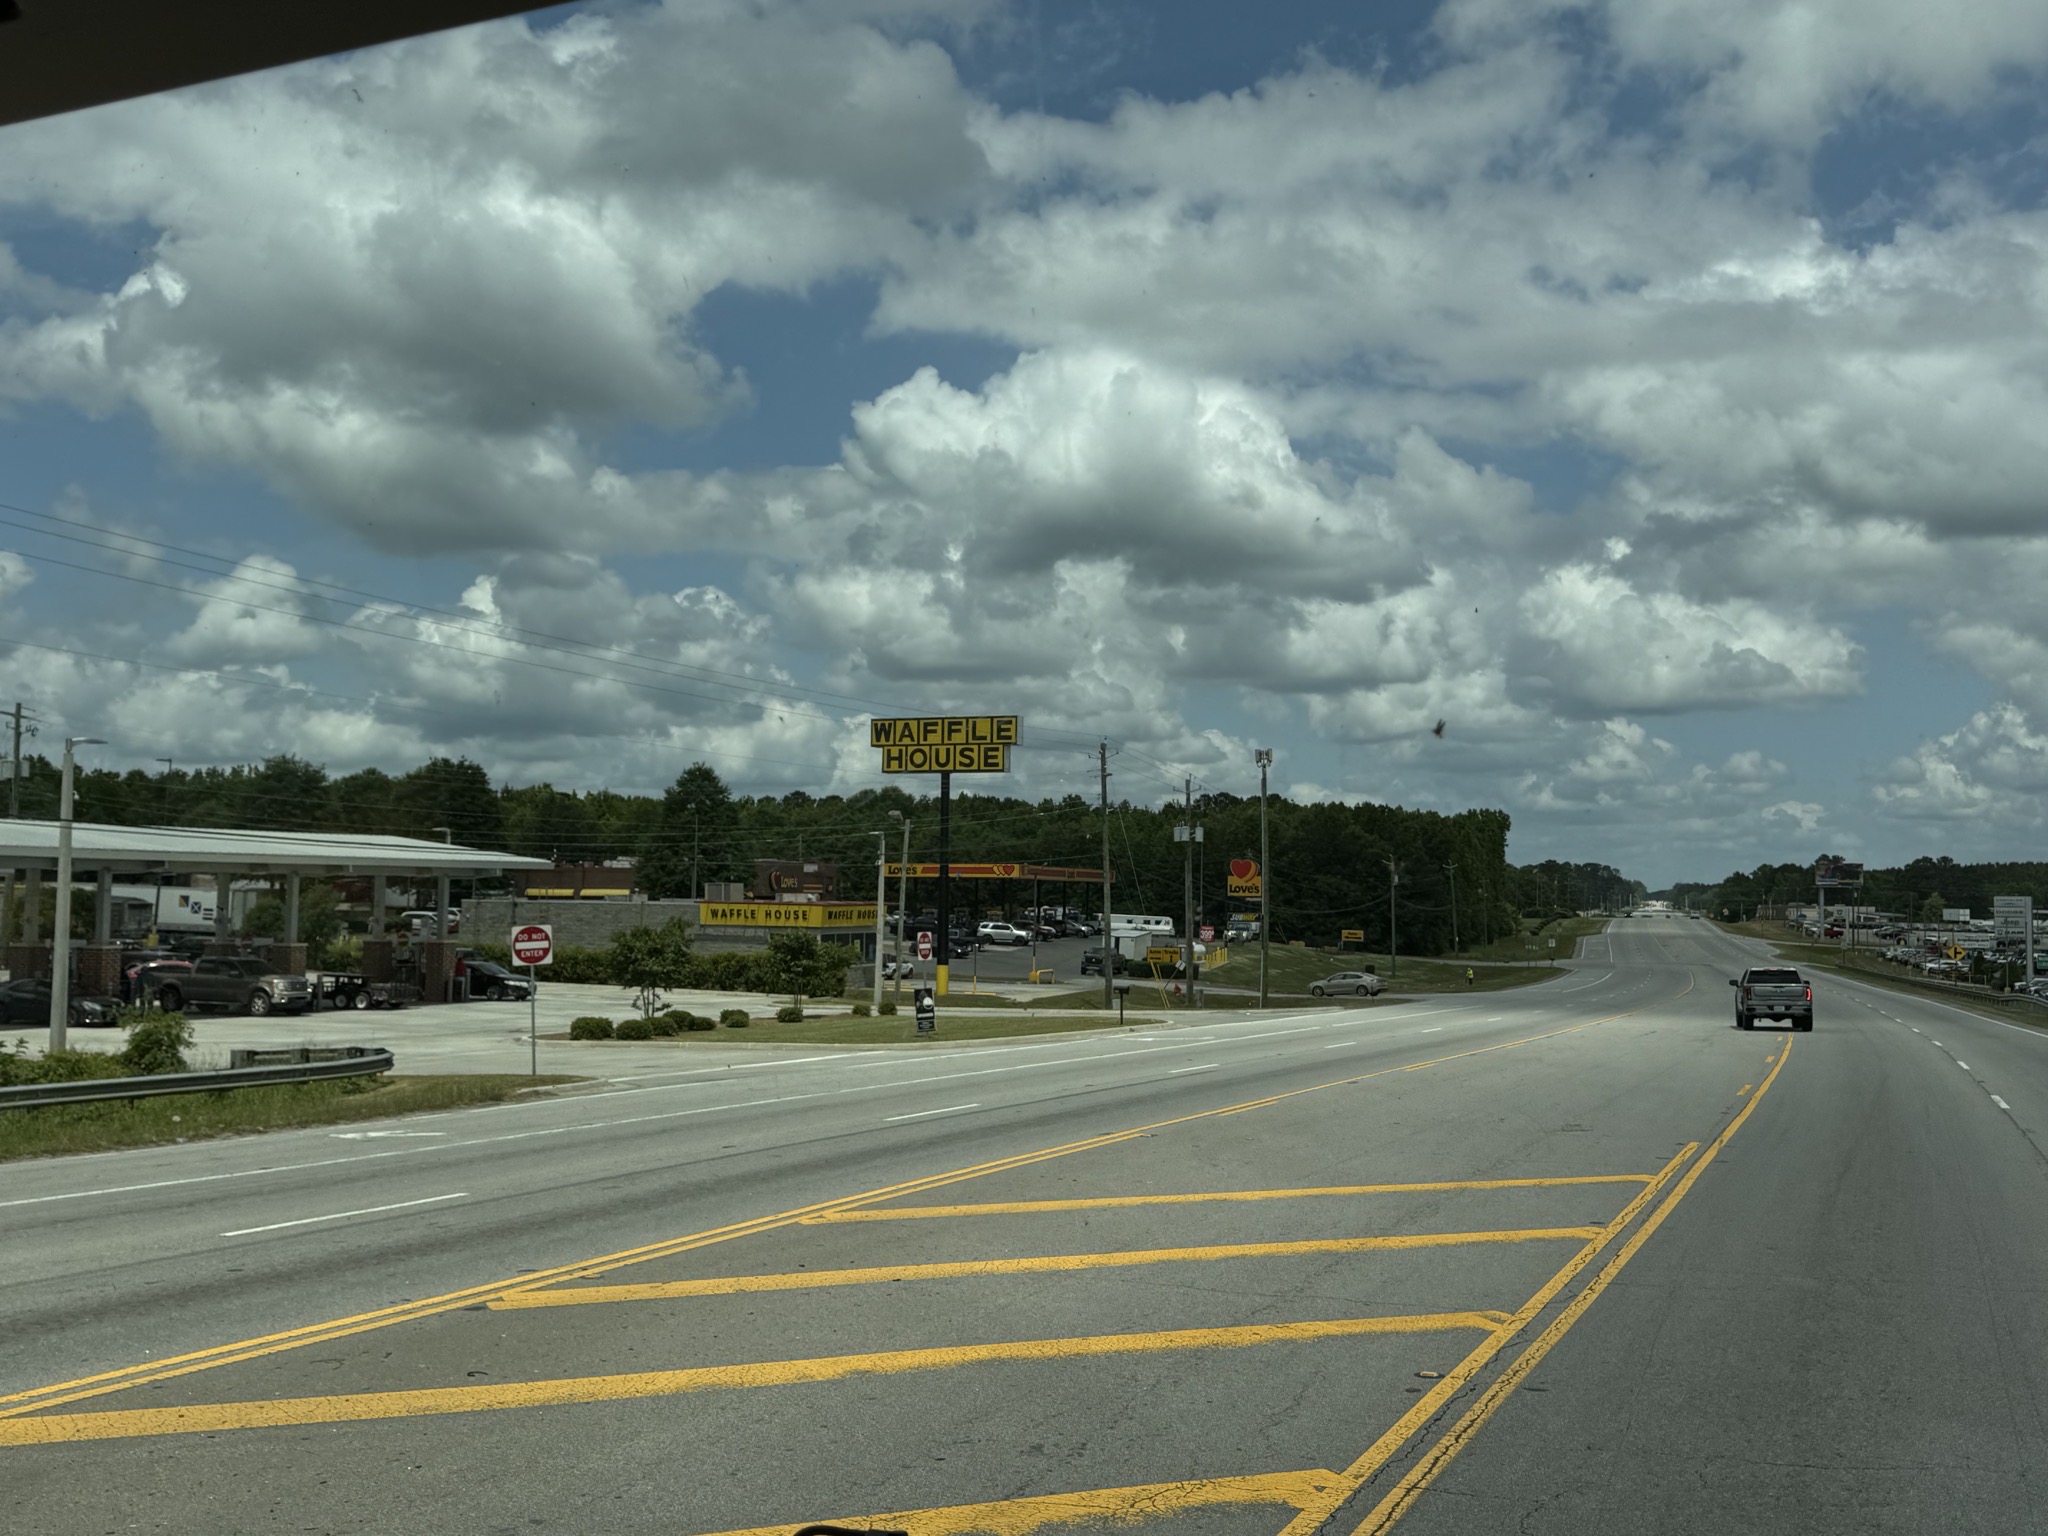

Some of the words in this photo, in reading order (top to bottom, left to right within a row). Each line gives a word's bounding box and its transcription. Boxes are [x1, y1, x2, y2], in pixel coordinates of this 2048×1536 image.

[873, 719, 1013, 743] WAFFLE
[886, 746, 1001, 769] HOUSE
[1229, 884, 1260, 894] Love's
[711, 908, 757, 920] WAFFLE
[765, 909, 808, 920] HOUSE
[828, 910, 854, 920] WAFFLE
[1230, 913, 1259, 921] SUBWAY
[518, 933, 528, 941] DO
[532, 932, 546, 940] NOT
[521, 950, 544, 958] ENTER
